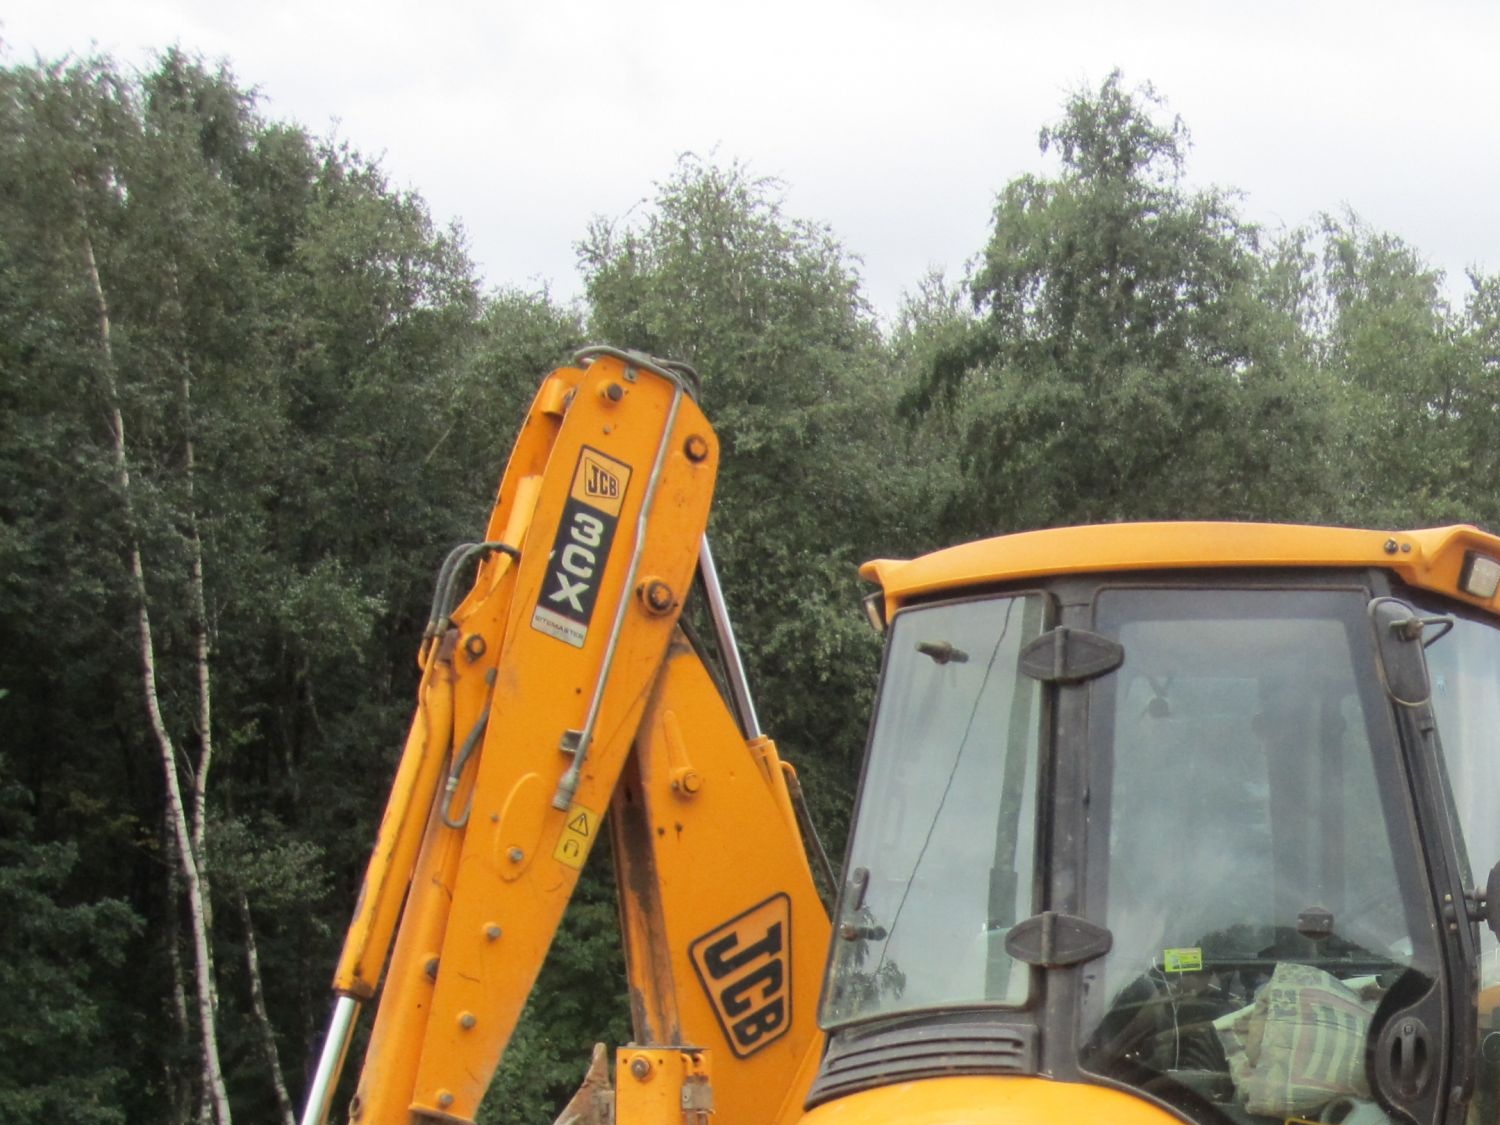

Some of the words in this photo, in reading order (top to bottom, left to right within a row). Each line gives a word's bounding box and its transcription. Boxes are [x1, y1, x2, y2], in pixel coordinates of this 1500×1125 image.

[587, 464, 617, 496] JCB
[548, 512, 604, 613] 3CX
[704, 920, 784, 1046] JCB
